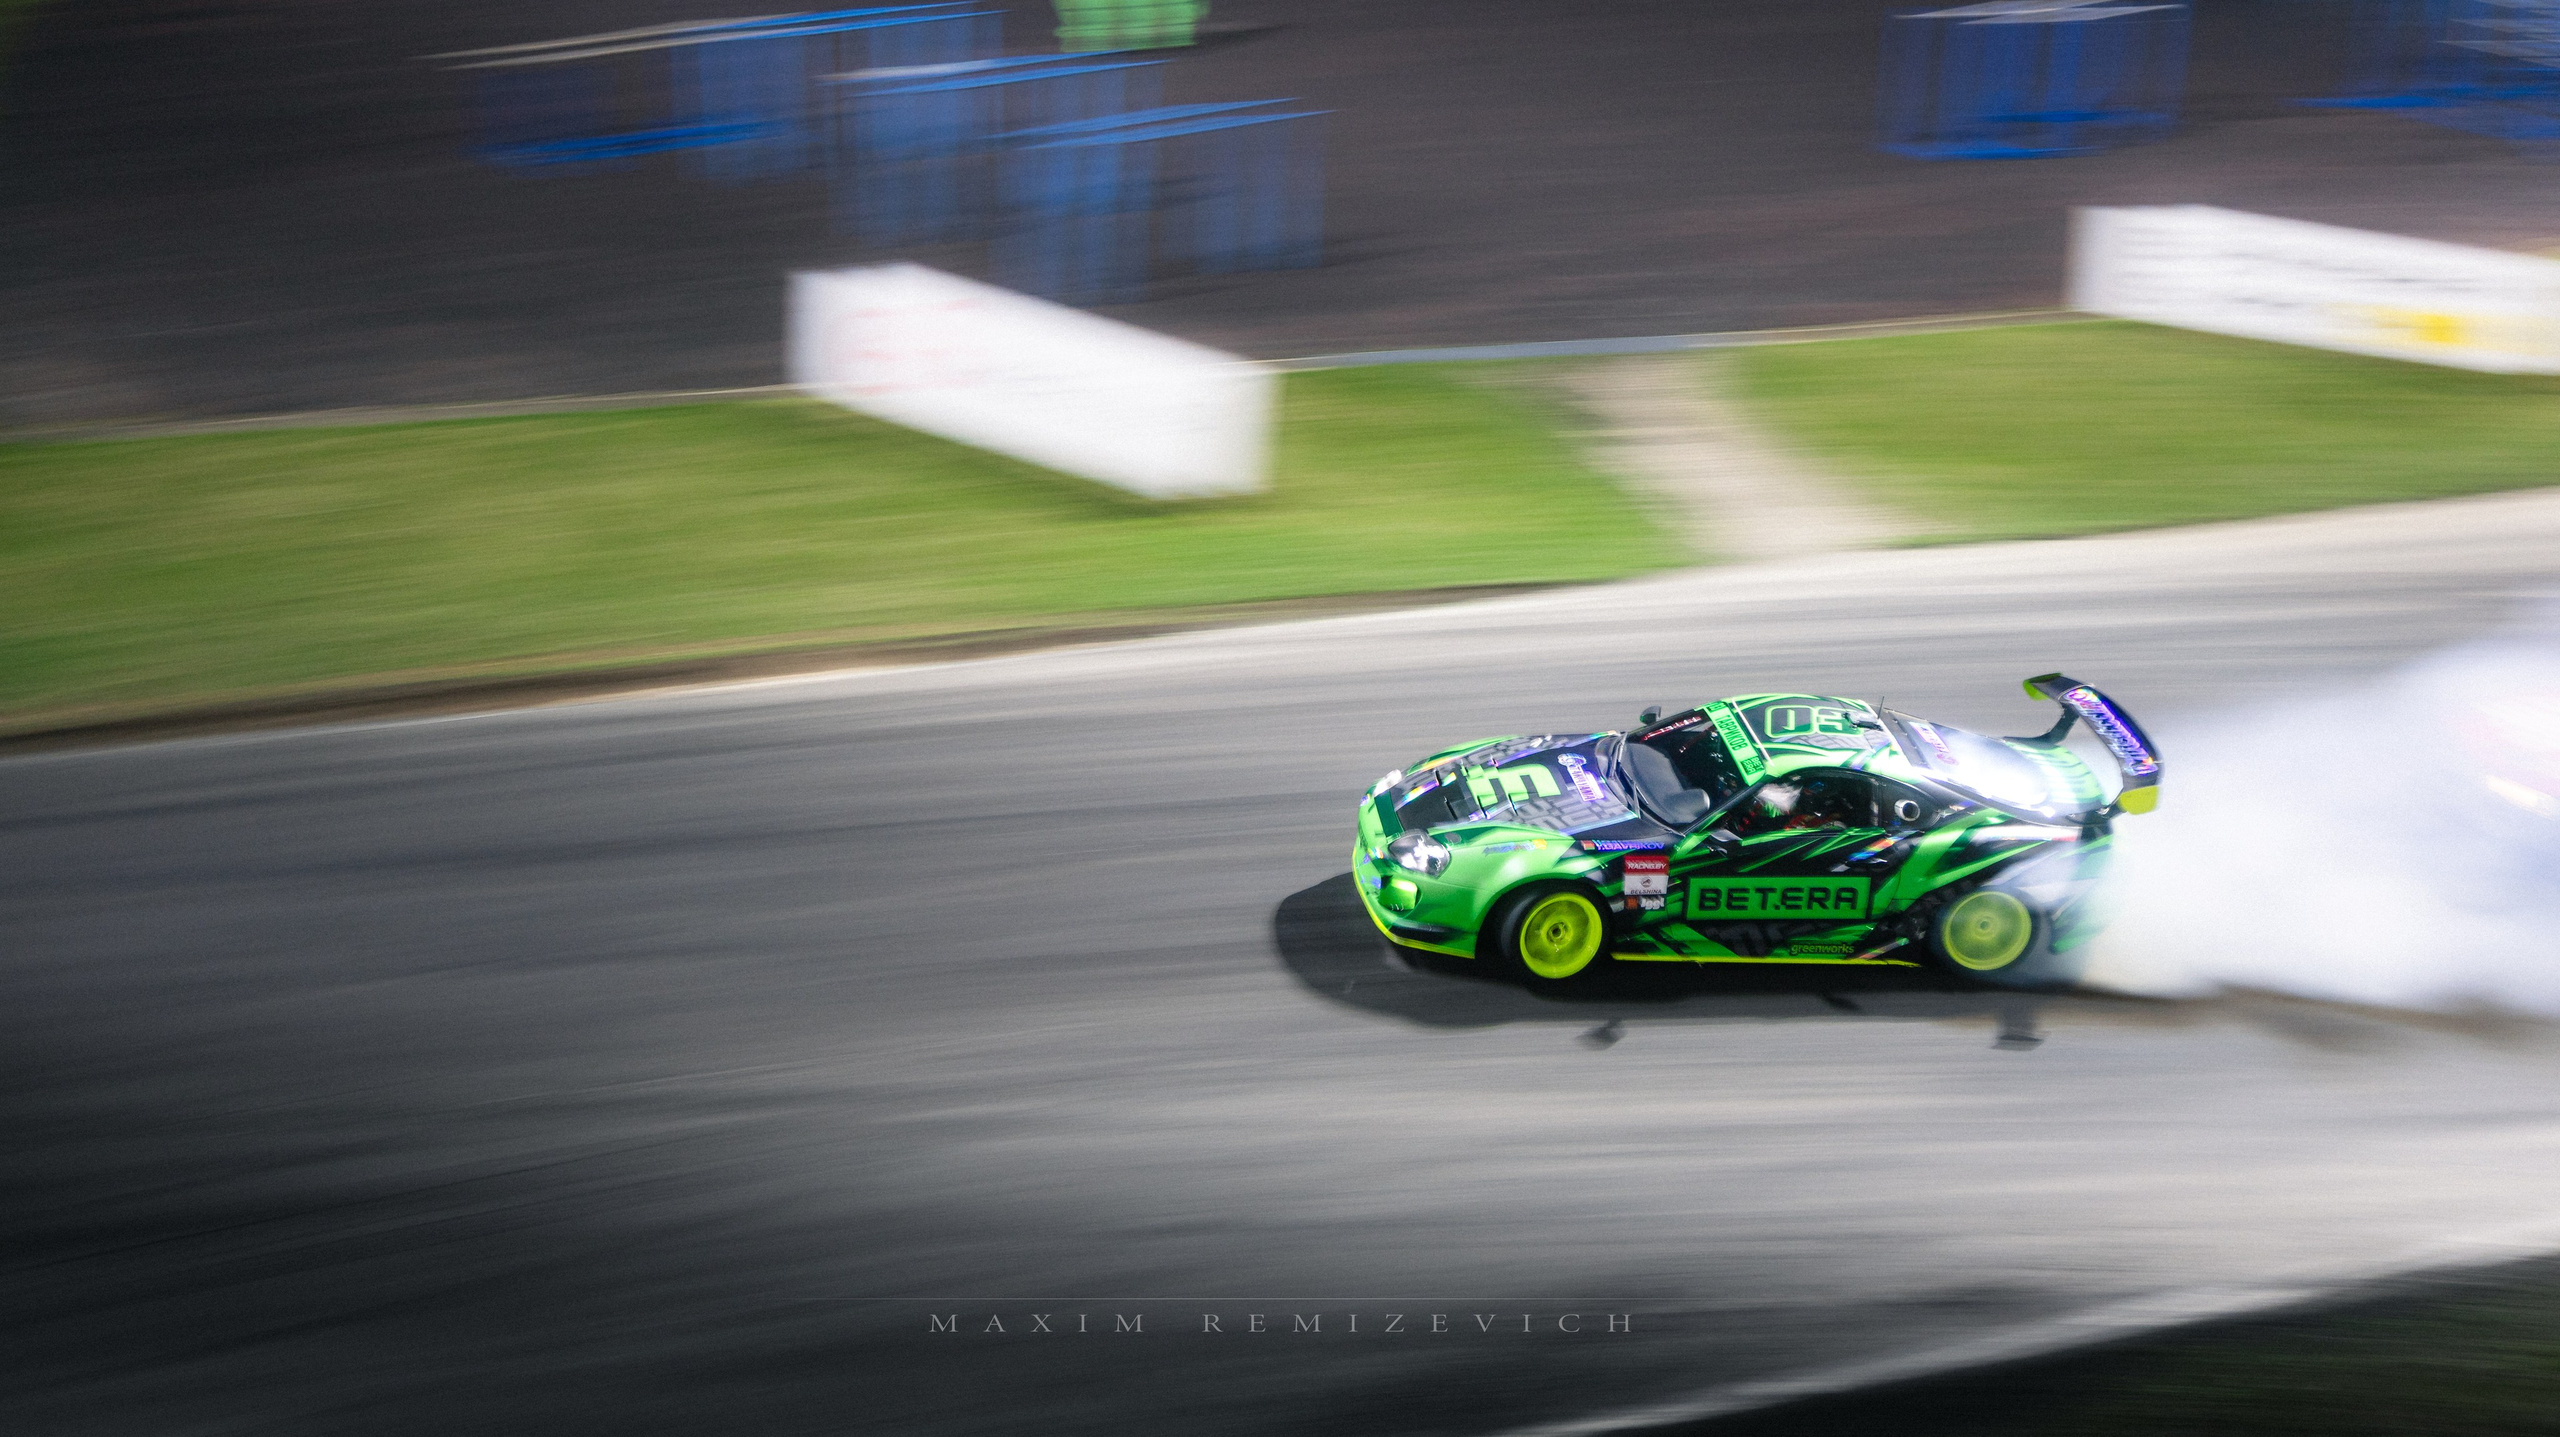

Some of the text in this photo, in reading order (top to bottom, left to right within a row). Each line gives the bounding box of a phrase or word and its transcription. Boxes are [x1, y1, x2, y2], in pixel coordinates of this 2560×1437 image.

[1717, 713, 1748, 752] ГАВРИКОВ
[1743, 759, 1757, 774] ERA
[1751, 756, 1764, 770] BET
[1791, 943, 1855, 955] greenworks
